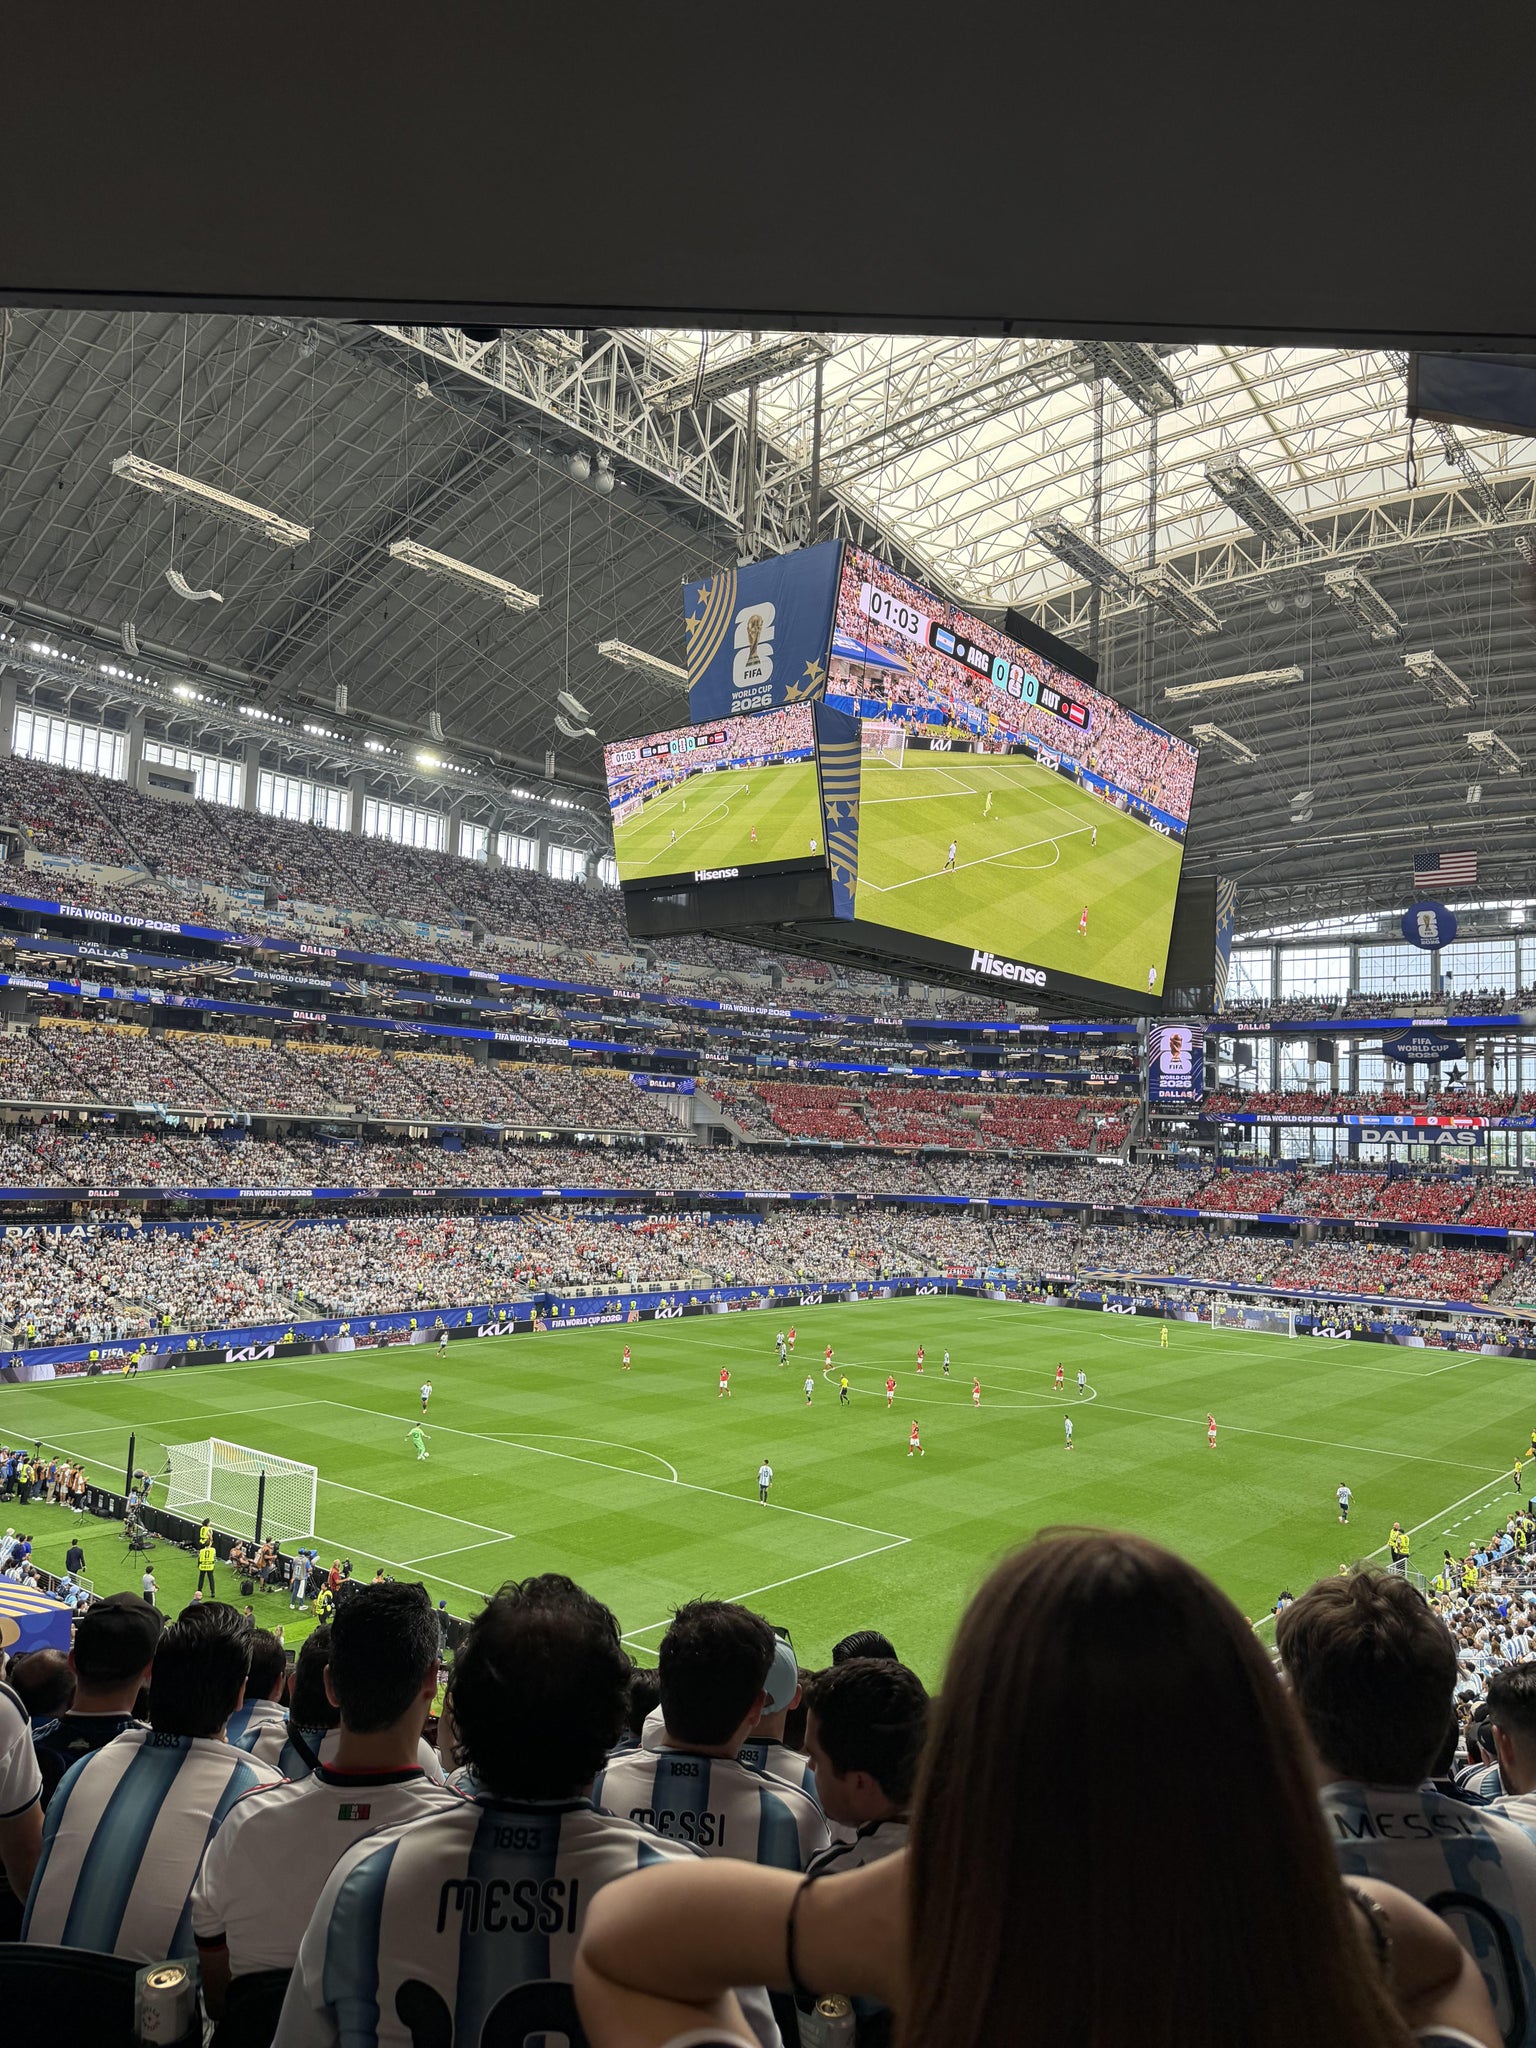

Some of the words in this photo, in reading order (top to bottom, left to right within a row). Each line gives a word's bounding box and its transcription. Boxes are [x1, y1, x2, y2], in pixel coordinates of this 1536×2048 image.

[872, 592, 919, 634] 01:03
[744, 668, 762, 680] FIFA
[966, 646, 989, 672] ARG
[996, 664, 1004, 680] 0
[1026, 681, 1034, 697] 0
[1041, 688, 1060, 710] AUT
[732, 686, 757, 700] WORLD
[758, 684, 773, 695] CUP
[730, 694, 772, 713] 2026
[672, 742, 677, 752] 0
[689, 740, 694, 748] 0
[930, 739, 952, 751] KIA
[616, 750, 636, 762] 01:03
[1036, 754, 1060, 772] KIA
[1149, 818, 1170, 836] KIA
[694, 868, 739, 882] Hisense
[60, 905, 82, 917] FIFA
[84, 909, 122, 924] WORLD
[123, 916, 144, 927] CUP
[145, 919, 181, 933] 2026
[78, 946, 128, 960] DALLAS
[300, 944, 336, 957] DALLAS
[970, 949, 1046, 987] Hisense
[254, 971, 269, 980] FIFA
[269, 973, 294, 983] WORLD
[294, 976, 308, 984] CUP
[308, 978, 332, 987] 2026
[435, 994, 472, 1005] DALLAS
[613, 990, 640, 999] DALLAS
[720, 1003, 734, 1011] FIFA
[734, 1004, 755, 1014] WORLD
[756, 1007, 768, 1015] CUP
[293, 1011, 327, 1022] DALLAS
[874, 1017, 902, 1025] DALLAS
[510, 1034, 532, 1043] WORLD
[741, 1031, 771, 1039] DALLAS
[1430, 1044, 1449, 1052] CUP
[705, 1053, 729, 1061] DALLAS
[649, 1080, 676, 1088] DALLAS
[1160, 1080, 1192, 1088] 2026
[1159, 1090, 1192, 1098] DALLAS
[1361, 1130, 1477, 1145] DALLAS
[916, 1286, 938, 1296] KIA
[800, 1295, 822, 1306] KIA
[655, 1307, 683, 1319] KIA
[1103, 1304, 1136, 1315] KIA
[552, 1320, 565, 1328] FIFA
[566, 1318, 586, 1327] WORLD
[587, 1317, 600, 1326] CUP
[601, 1315, 621, 1323] 2026
[478, 1322, 514, 1337] KIA
[1312, 1327, 1351, 1339] KIA
[1455, 1333, 1474, 1342] FIFA
[102, 1348, 123, 1359] FIFA
[226, 1344, 275, 1363] KIA
[152, 1733, 180, 1748] 1893
[670, 1762, 699, 1777] 1893
[630, 1808, 725, 1847] MESSI
[1334, 1812, 1474, 1840] MESSI
[494, 1826, 542, 1850] 1893
[436, 1878, 579, 1934] MESSI
